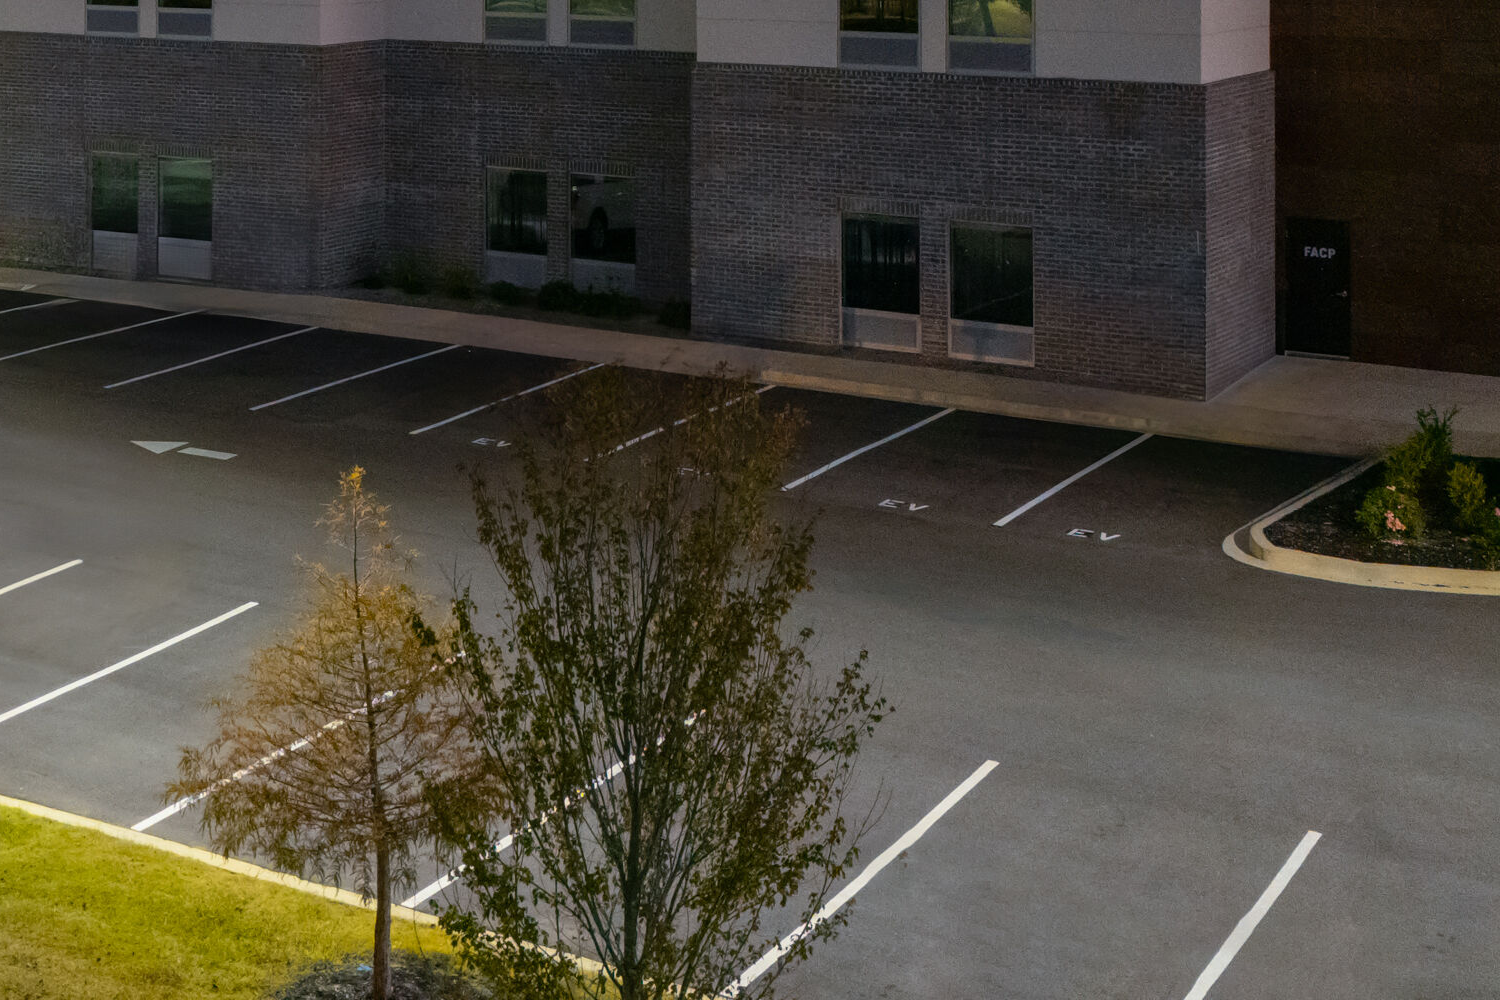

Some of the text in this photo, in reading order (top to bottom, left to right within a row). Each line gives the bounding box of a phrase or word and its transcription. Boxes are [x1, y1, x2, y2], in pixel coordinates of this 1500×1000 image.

[1303, 246, 1336, 259] FACP
[471, 437, 512, 448] EV
[878, 499, 930, 511] EV
[1066, 528, 1121, 541] EV
